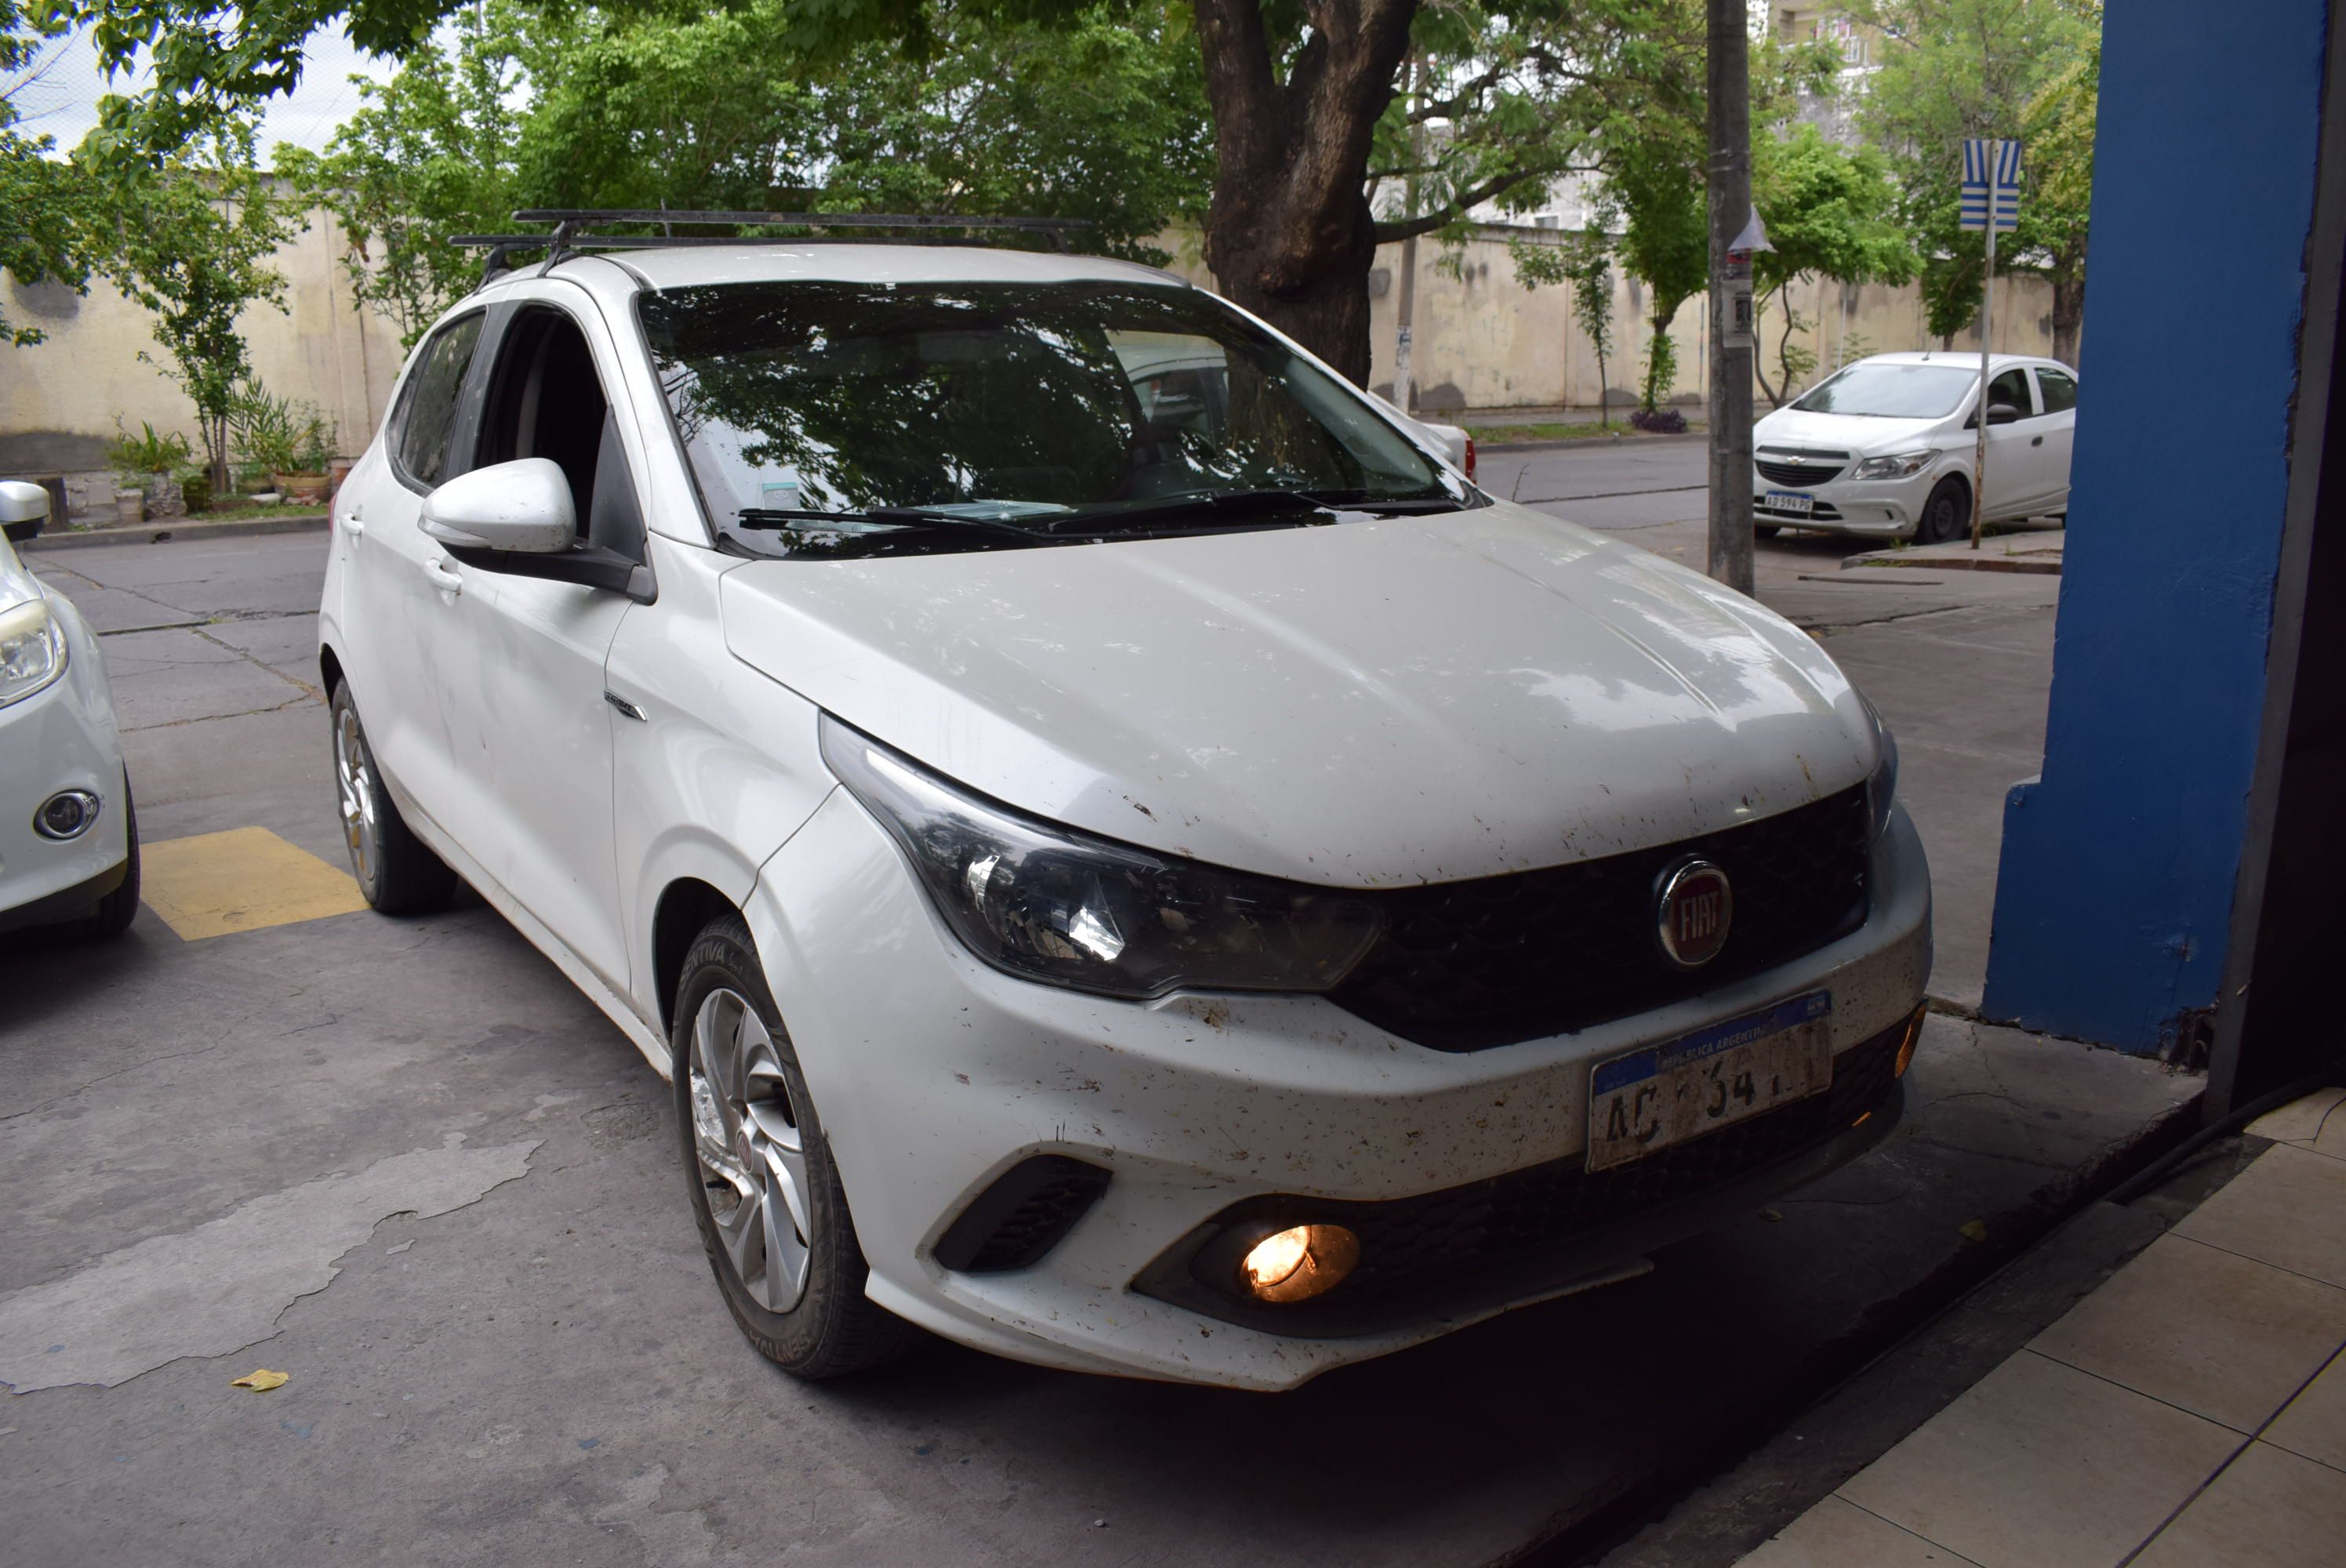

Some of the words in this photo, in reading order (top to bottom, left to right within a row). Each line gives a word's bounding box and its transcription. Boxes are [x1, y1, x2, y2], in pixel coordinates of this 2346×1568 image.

[1767, 496, 1778, 507] AD
[1780, 497, 1796, 508] 594
[1799, 499, 1811, 510] PG
[1680, 889, 1720, 942] FIAT
[680, 940, 726, 992] SENTIVA
[1607, 1085, 1658, 1145] AC
